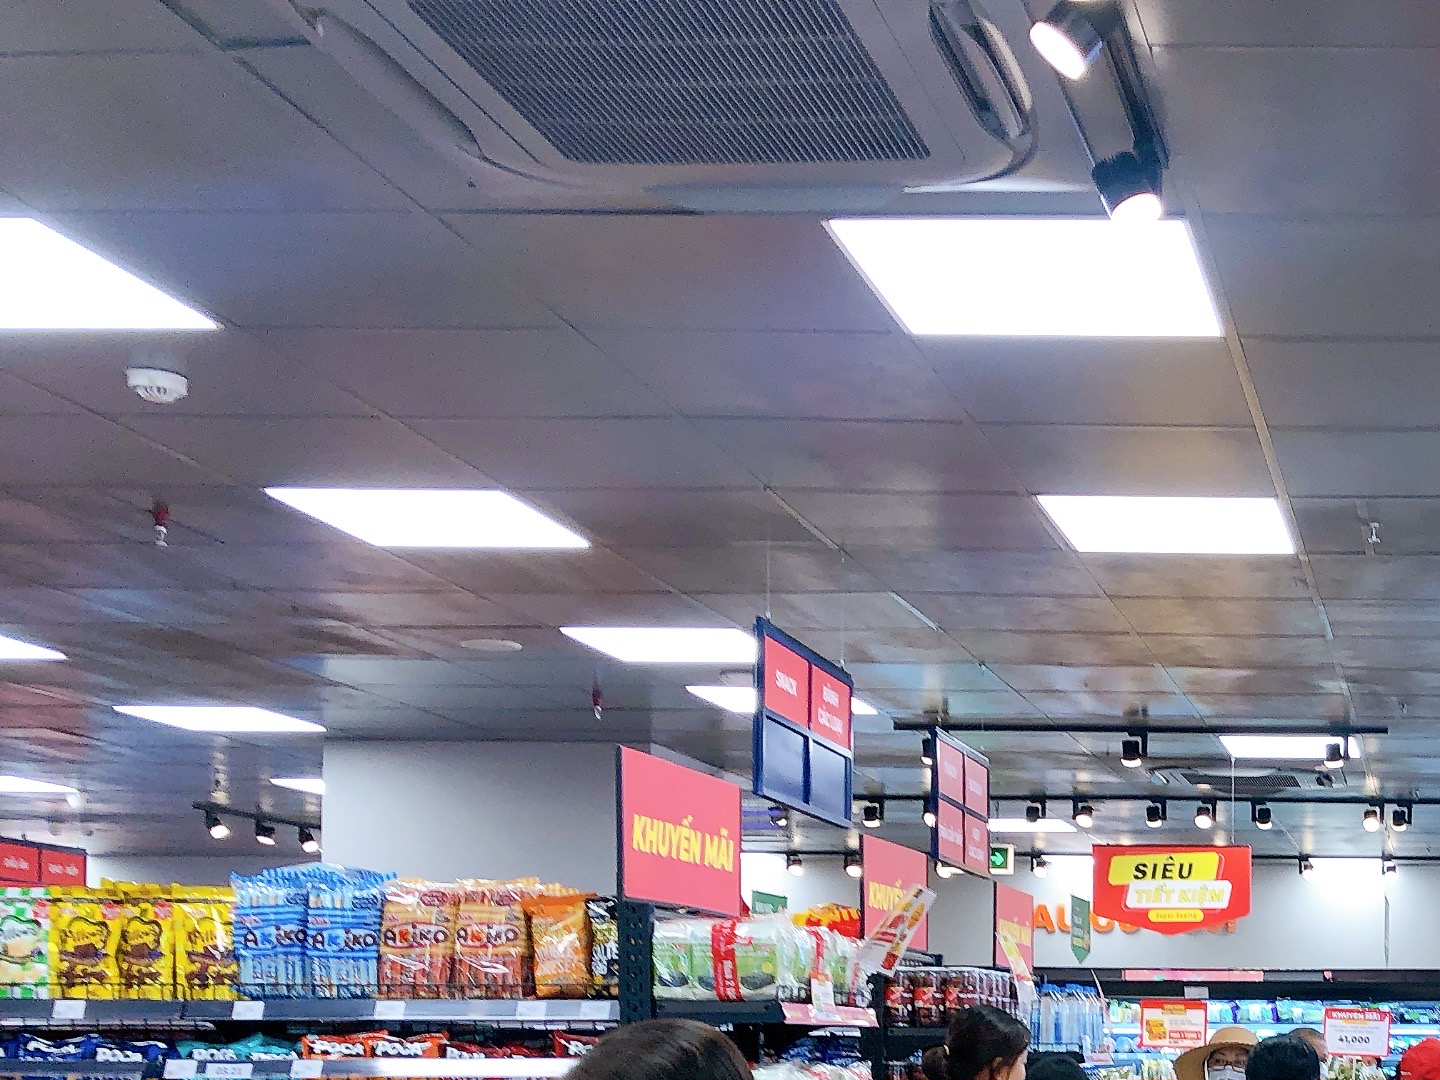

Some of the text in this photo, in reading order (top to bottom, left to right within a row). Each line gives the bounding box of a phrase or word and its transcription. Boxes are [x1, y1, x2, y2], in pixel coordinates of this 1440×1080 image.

[633, 814, 734, 873] KHUYẾN MÃI
[1133, 856, 1193, 880] SIÊU
[1135, 882, 1225, 907] TIẾT KIỆM
[1338, 1034, 1370, 1044] 41,000
